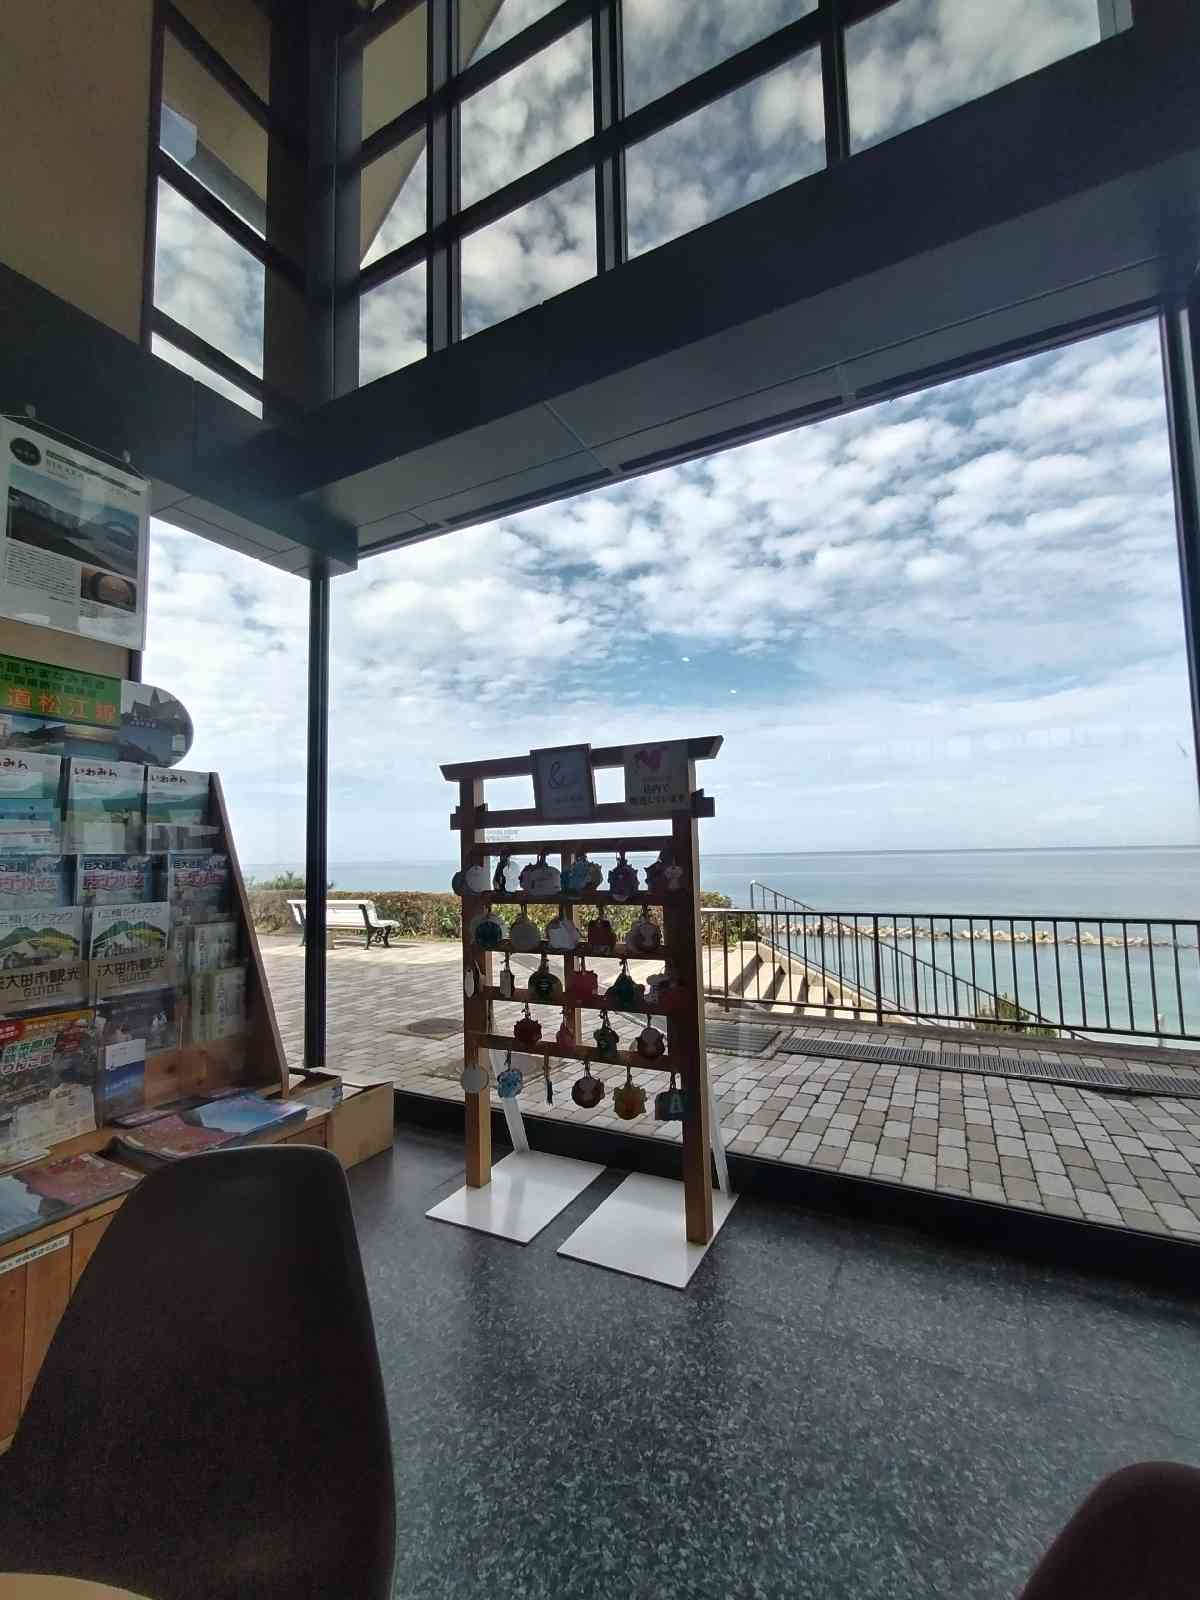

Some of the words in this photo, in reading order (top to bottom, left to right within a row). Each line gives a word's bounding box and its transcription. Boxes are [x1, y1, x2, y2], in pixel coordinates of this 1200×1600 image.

[74, 767, 117, 777] いわみん
[150, 775, 187, 785] いわみん
[24, 983, 65, 998] GUIDE
